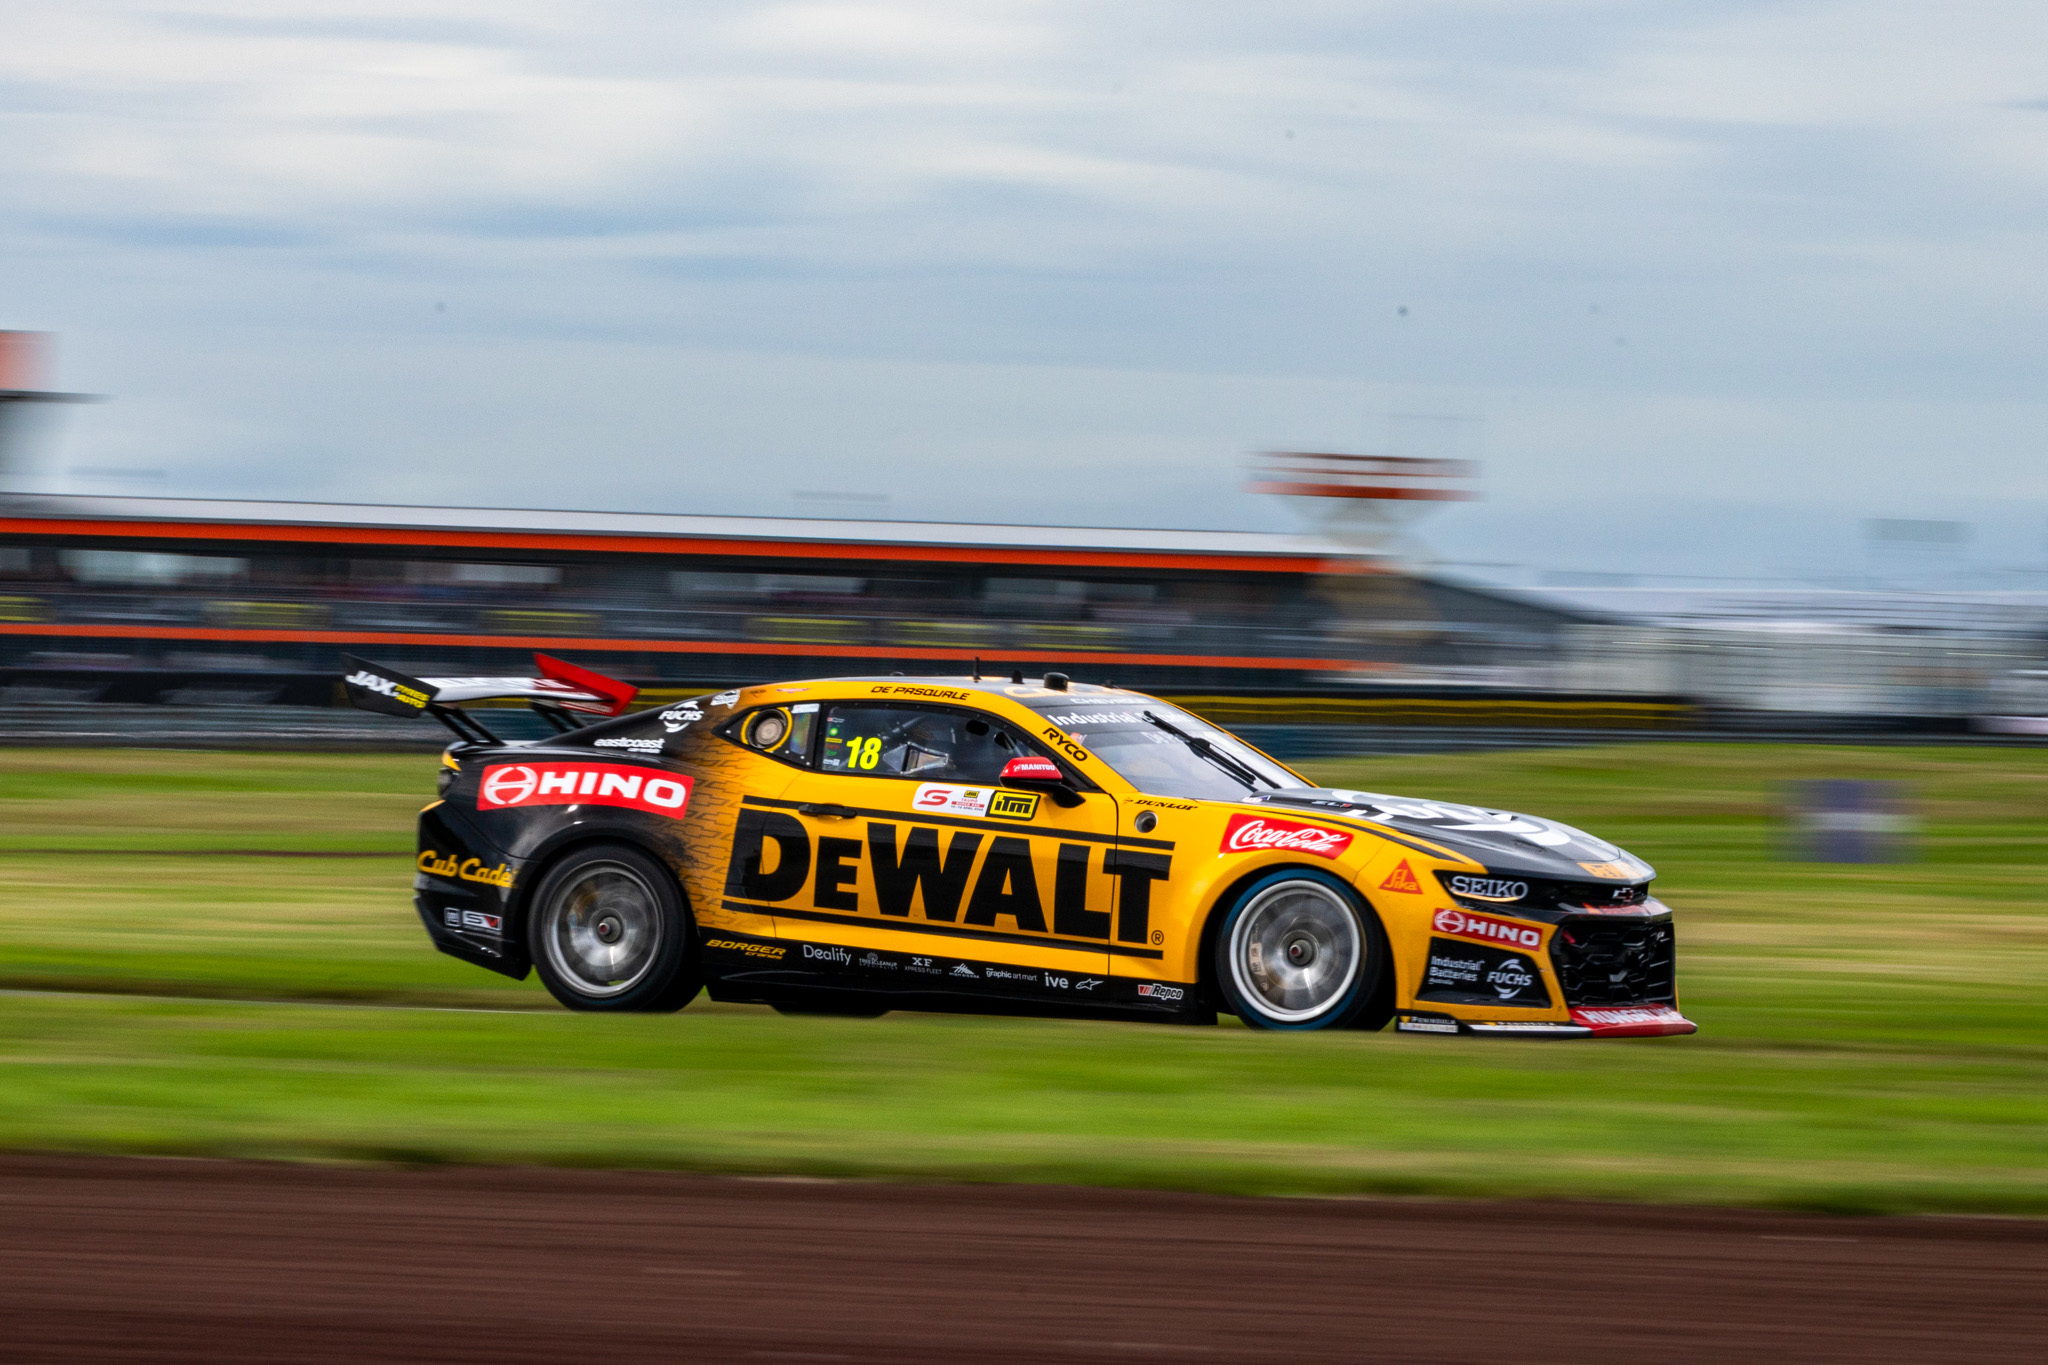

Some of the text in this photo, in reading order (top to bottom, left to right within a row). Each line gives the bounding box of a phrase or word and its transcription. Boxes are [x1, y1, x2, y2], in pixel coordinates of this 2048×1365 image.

[871, 686, 970, 700] DE PASQUALE
[658, 710, 704, 721] FUCHS
[1047, 711, 1140, 727] Industrial
[593, 737, 665, 749] eastcoast
[1043, 727, 1088, 762] RYCO
[846, 736, 882, 770] 18
[538, 770, 687, 808] HINO
[1135, 799, 1198, 810] DUNLOP
[417, 850, 459, 877] Cub
[1384, 869, 1417, 891] Sika
[1451, 875, 1529, 899] SEIKO
[1467, 918, 1541, 946] HINO
[705, 939, 787, 955] BORGER
[745, 951, 783, 960] cranes
[803, 944, 851, 966] Dealify
[912, 957, 933, 967] XF
[1431, 956, 1481, 971] Industrial
[986, 970, 1012, 979] graphic
[1045, 973, 1068, 988] ive
[1429, 967, 1478, 982] Batteries
[1486, 971, 1533, 986] FUCHS
[1150, 984, 1183, 999] Repco
